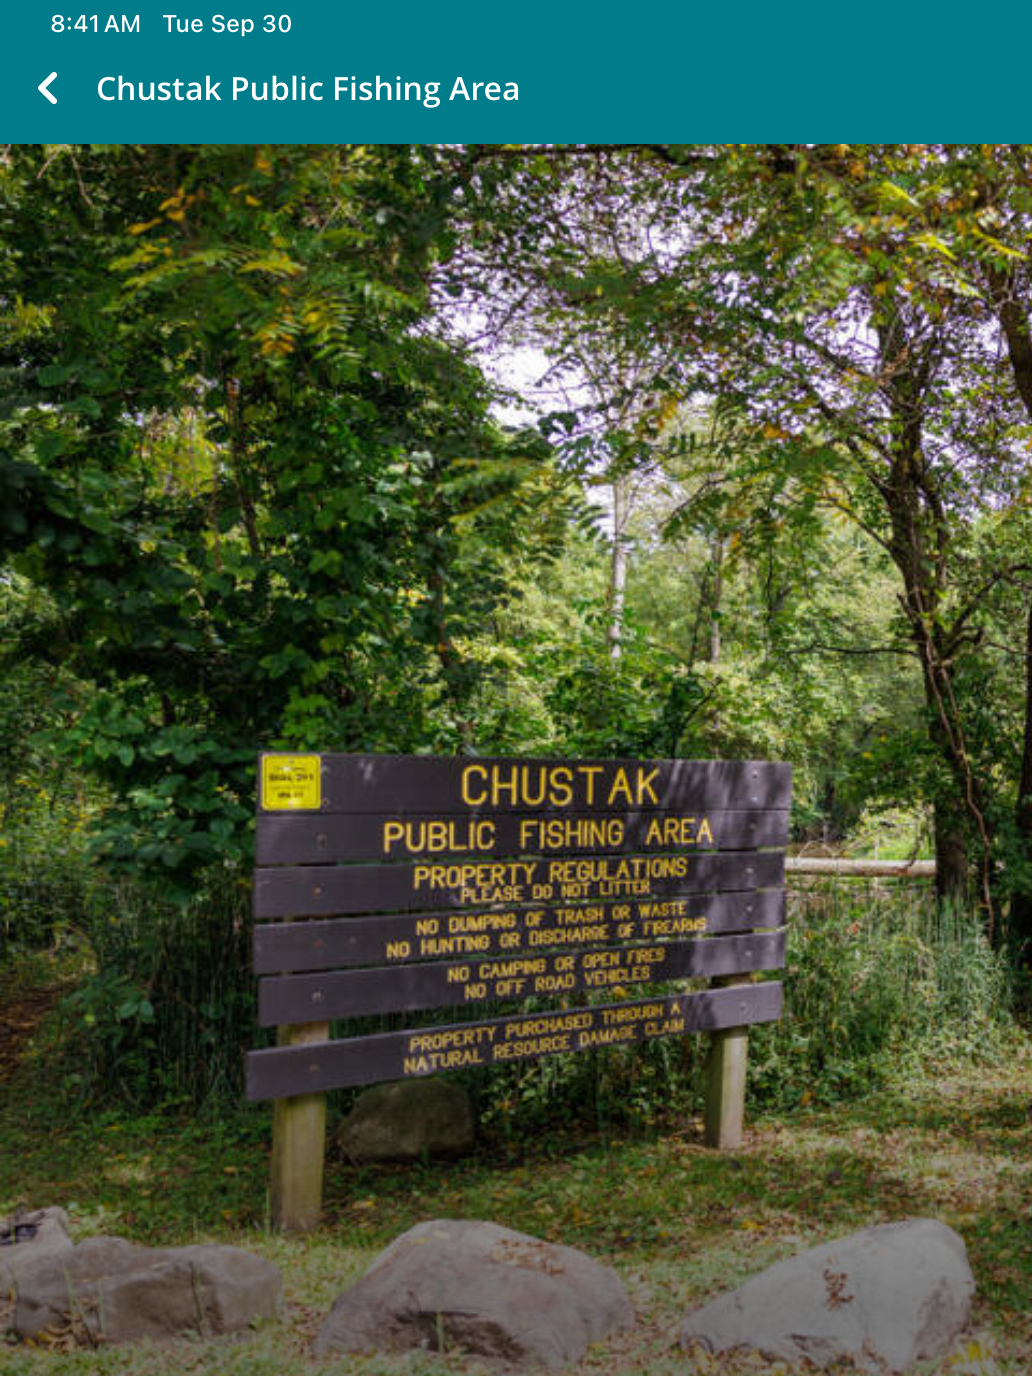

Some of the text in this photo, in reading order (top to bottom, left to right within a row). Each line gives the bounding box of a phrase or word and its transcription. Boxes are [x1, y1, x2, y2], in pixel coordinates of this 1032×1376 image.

[50, 14, 140, 33] 8:41 AM
[162, 14, 292, 37] Tue Sep 30
[97, 75, 519, 109] Chustak Public Fishing Area
[461, 765, 660, 806] CHUSTAK
[383, 817, 714, 852] PUBLIC FISHING AREA
[414, 858, 687, 889] PROPERTY REGULATIONS
[460, 879, 650, 903] PLEASE DO NOT LITTER
[416, 901, 688, 936] NO DUMPING OF TRASH OR WASTE
[386, 916, 707, 959] NO HUNTING OR DISCHARGE OF FIREARMS
[447, 947, 666, 984] NO CAMPING OR OPEN FIRES
[465, 965, 651, 1000] NO OFF ROAD VEHICLES
[410, 1002, 681, 1053] PROPERTY PURCHASED THROUGH A
[404, 1018, 685, 1073] NATURAL RESOURCE DAMAGE CLAIM
